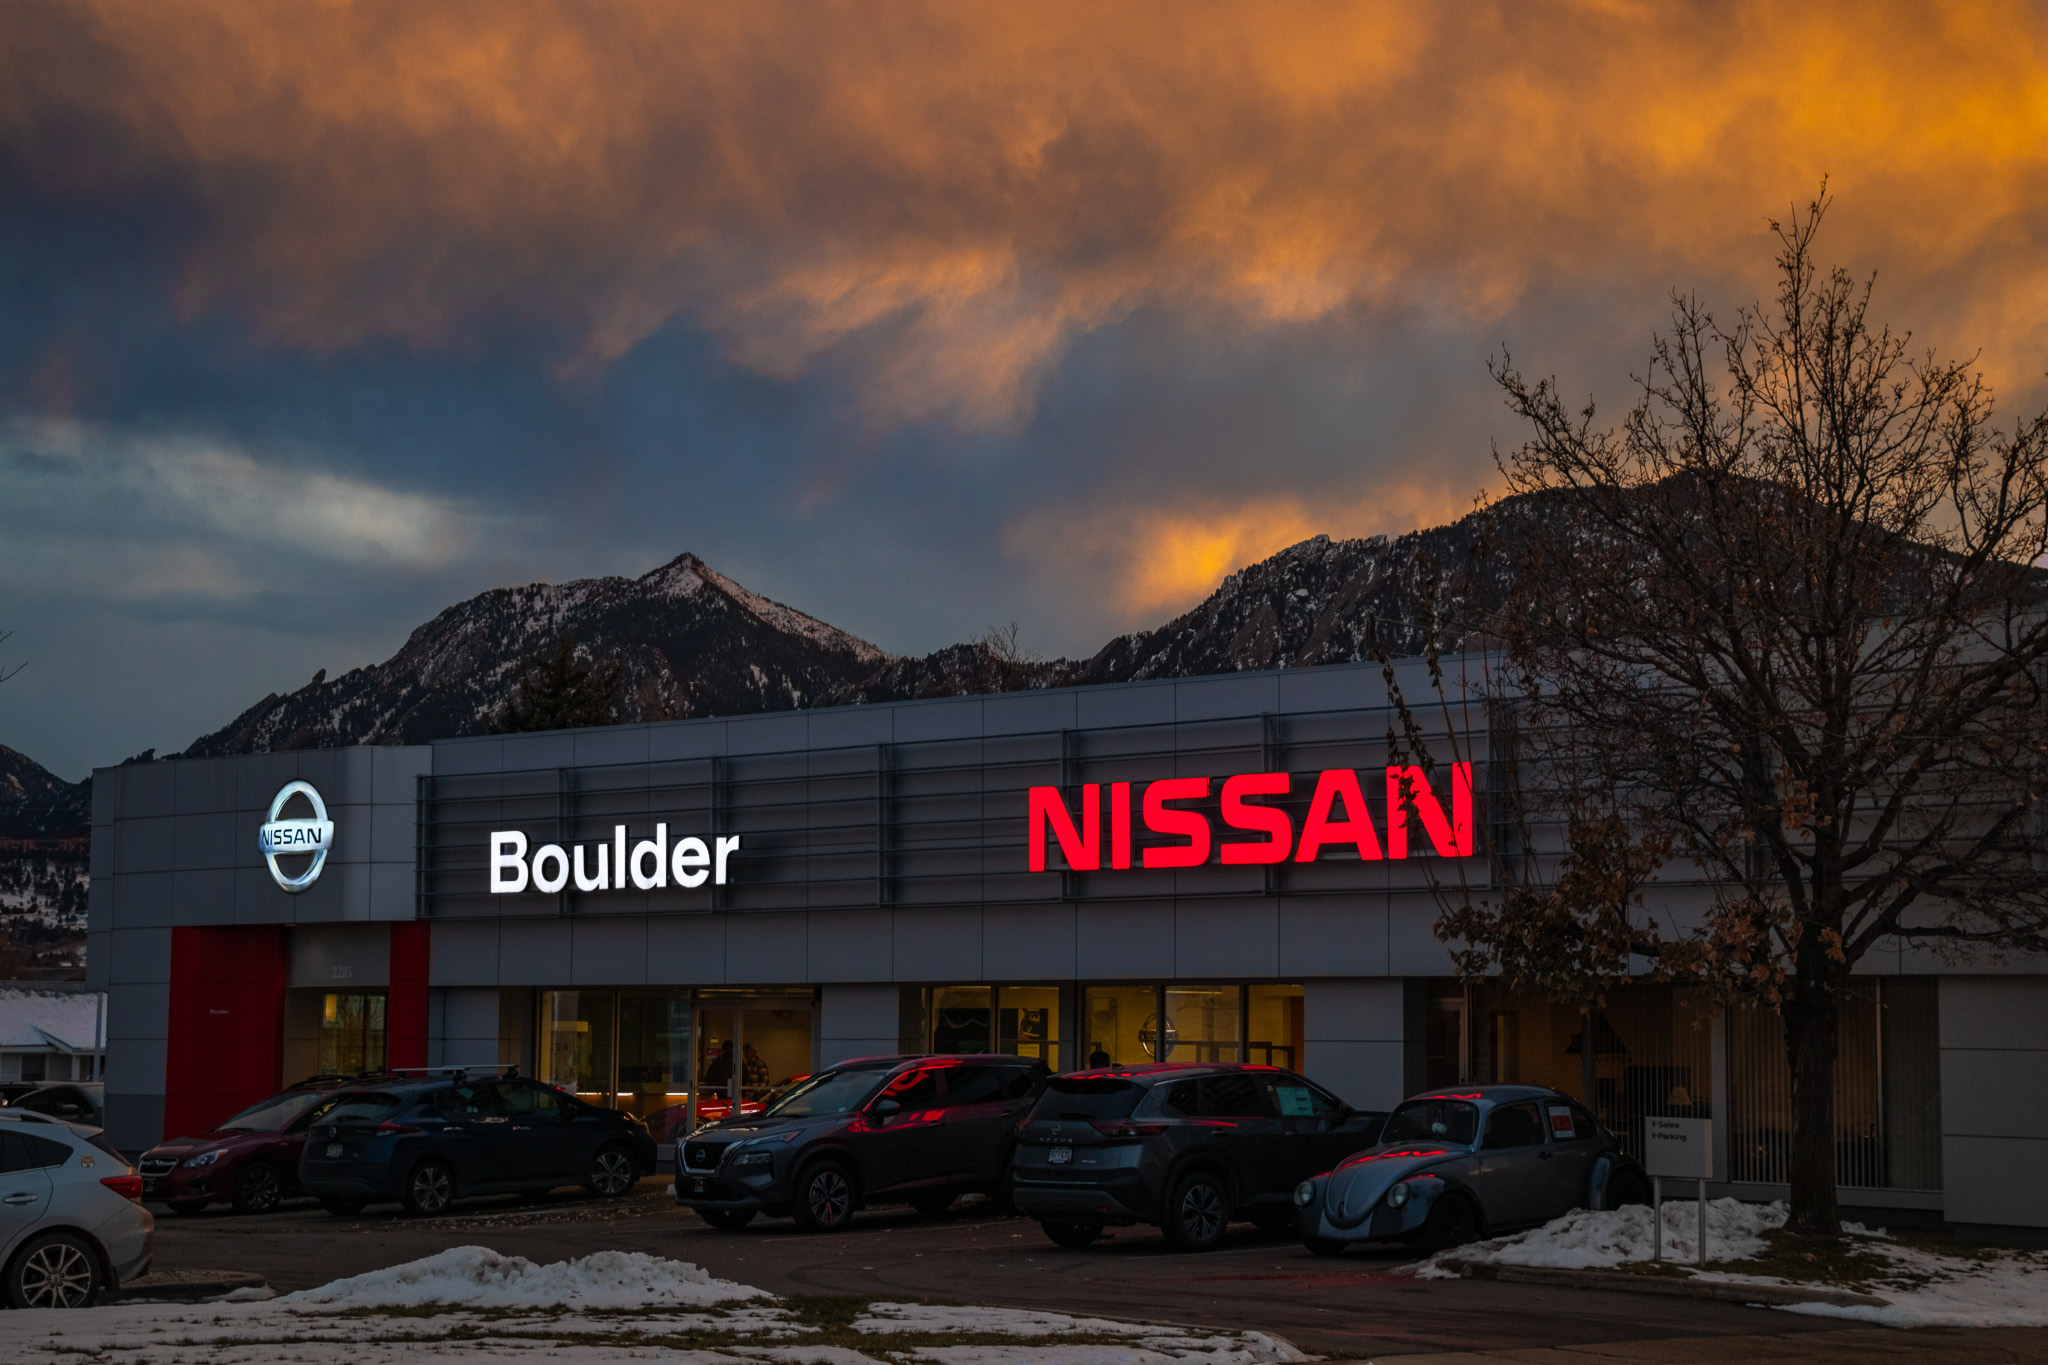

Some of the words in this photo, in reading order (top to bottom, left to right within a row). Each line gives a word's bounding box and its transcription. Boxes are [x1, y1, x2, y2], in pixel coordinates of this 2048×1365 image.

[1028, 761, 1474, 872] NISSAN
[262, 828, 322, 846] NISSAN
[490, 822, 740, 894] Boulder
[331, 966, 353, 979] 2285
[1658, 1120, 1680, 1128] Sales
[1657, 1132, 1687, 1142] Parking
